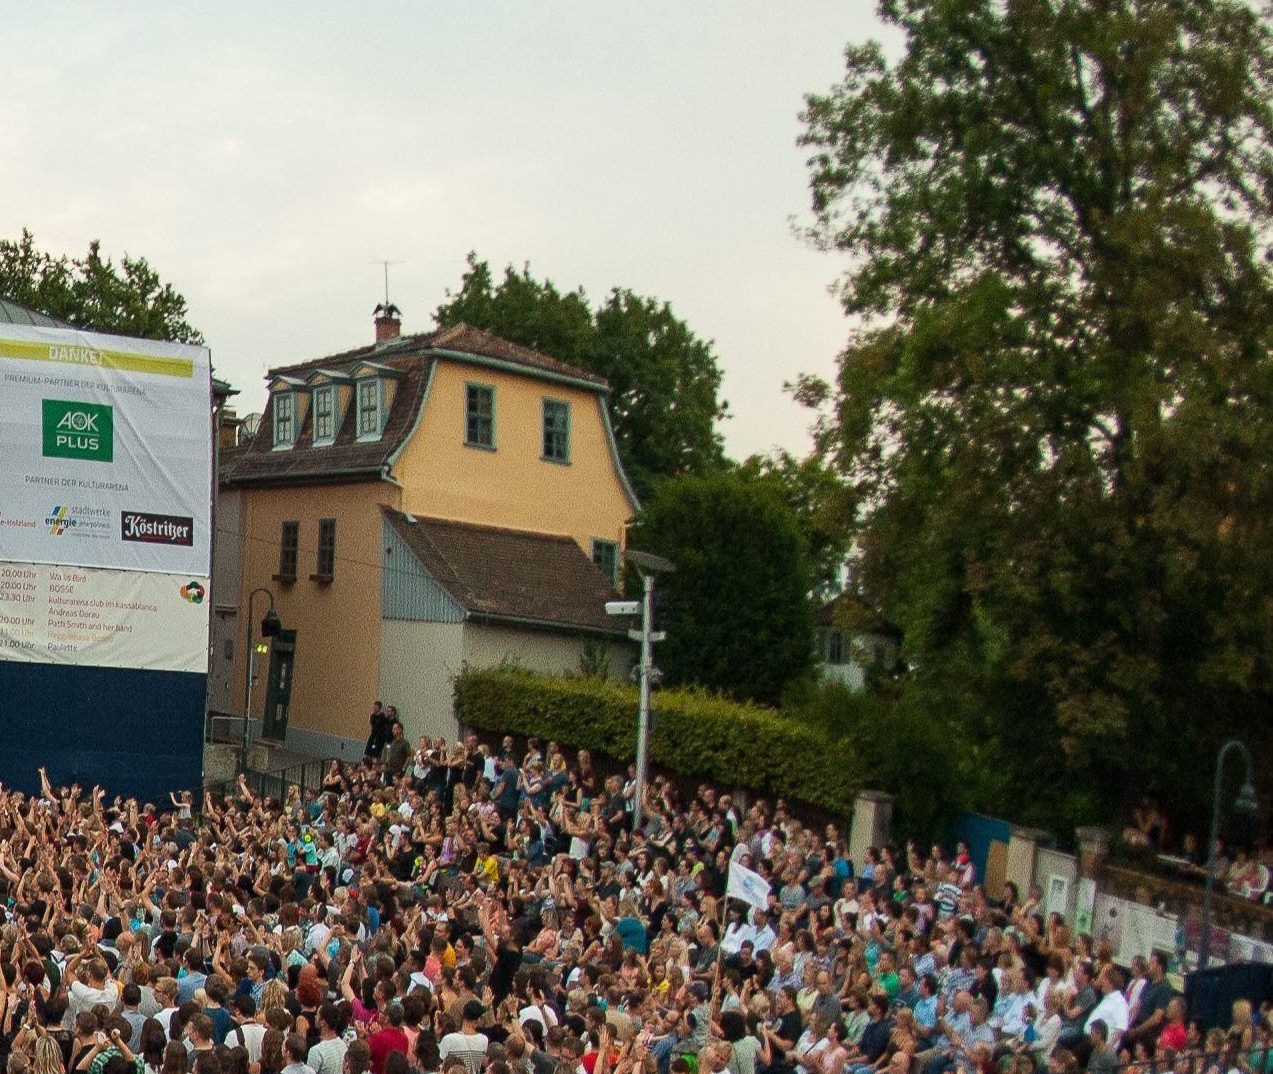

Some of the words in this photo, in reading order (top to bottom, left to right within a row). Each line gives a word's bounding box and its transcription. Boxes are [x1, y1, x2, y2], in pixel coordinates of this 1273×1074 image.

[56, 412, 99, 431] AOK
[56, 435, 99, 450] PLUS
[25, 475, 59, 486] PARTNER
[61, 478, 76, 487] DER
[78, 480, 129, 491] KULTURARENA
[45, 517, 77, 528] energie
[125, 515, 189, 539] Köstritzer
[23, 570, 37, 578] Uhr
[23, 583, 37, 591] Uhr
[22, 594, 36, 602] Uhr
[48, 608, 78, 617] Andreas
[21, 617, 35, 625] Uhr
[66, 620, 87, 629] Smith
[47, 642, 78, 652] Paulette
